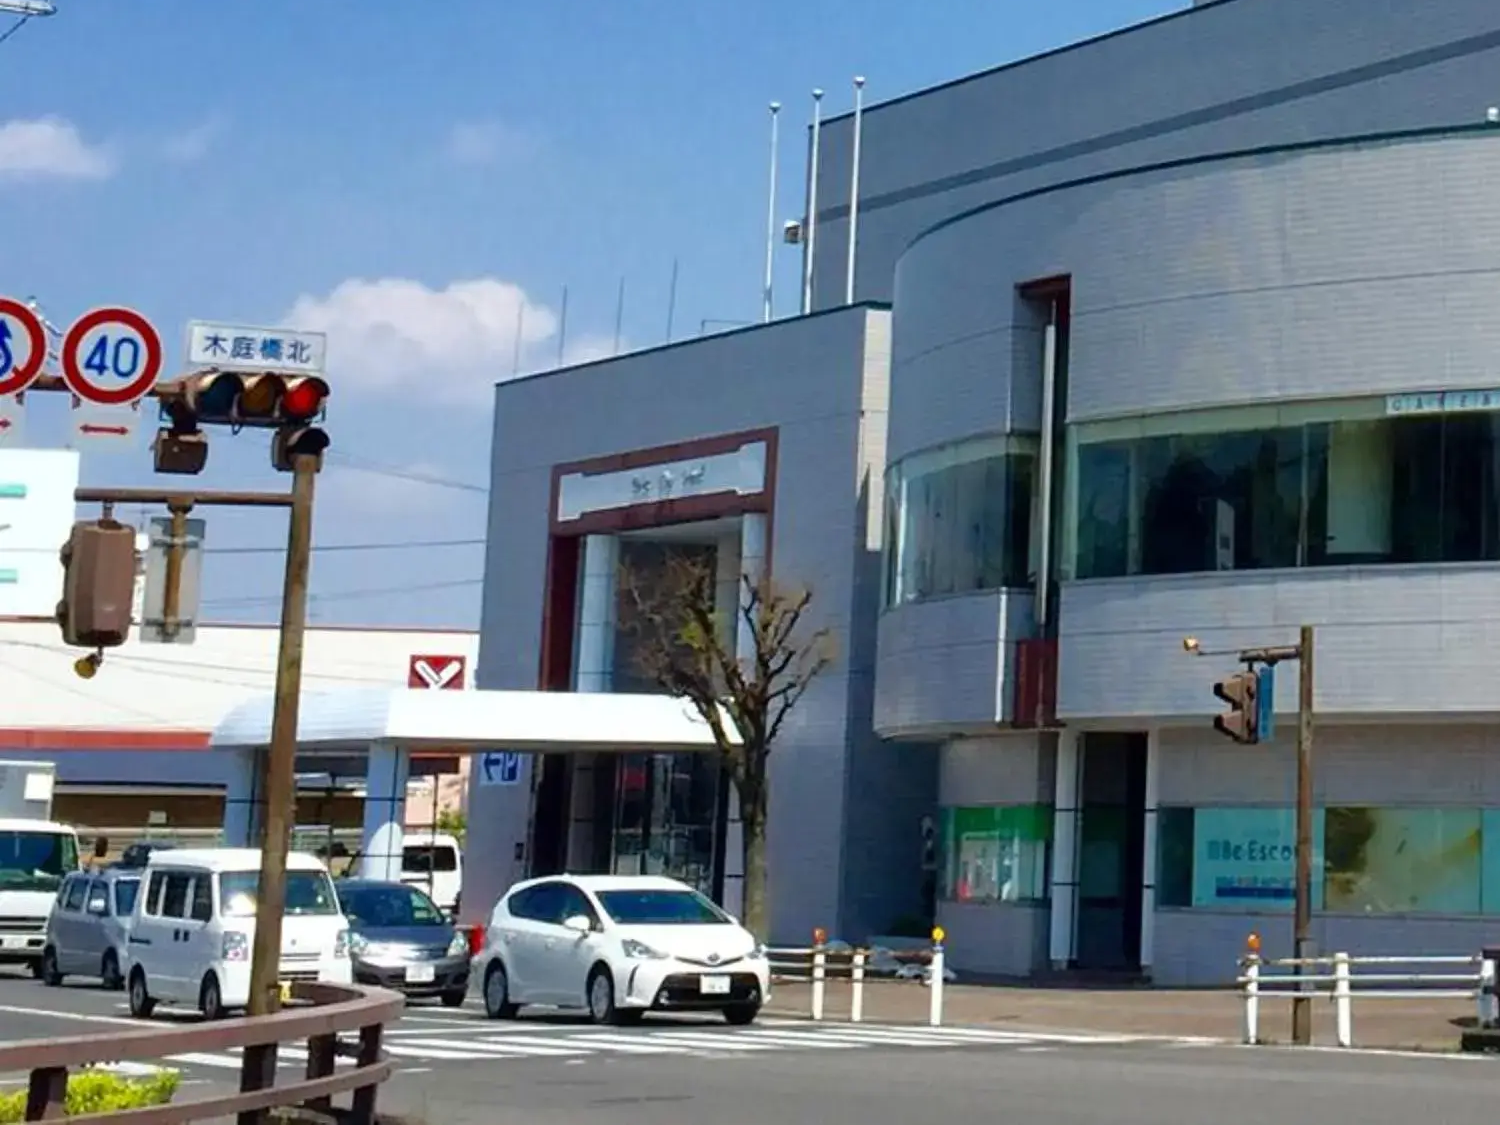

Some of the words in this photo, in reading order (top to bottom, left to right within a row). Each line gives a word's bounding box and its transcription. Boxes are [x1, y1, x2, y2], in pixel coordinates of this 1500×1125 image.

[84, 334, 140, 378] 40
[202, 332, 312, 365] 木庭橋北
